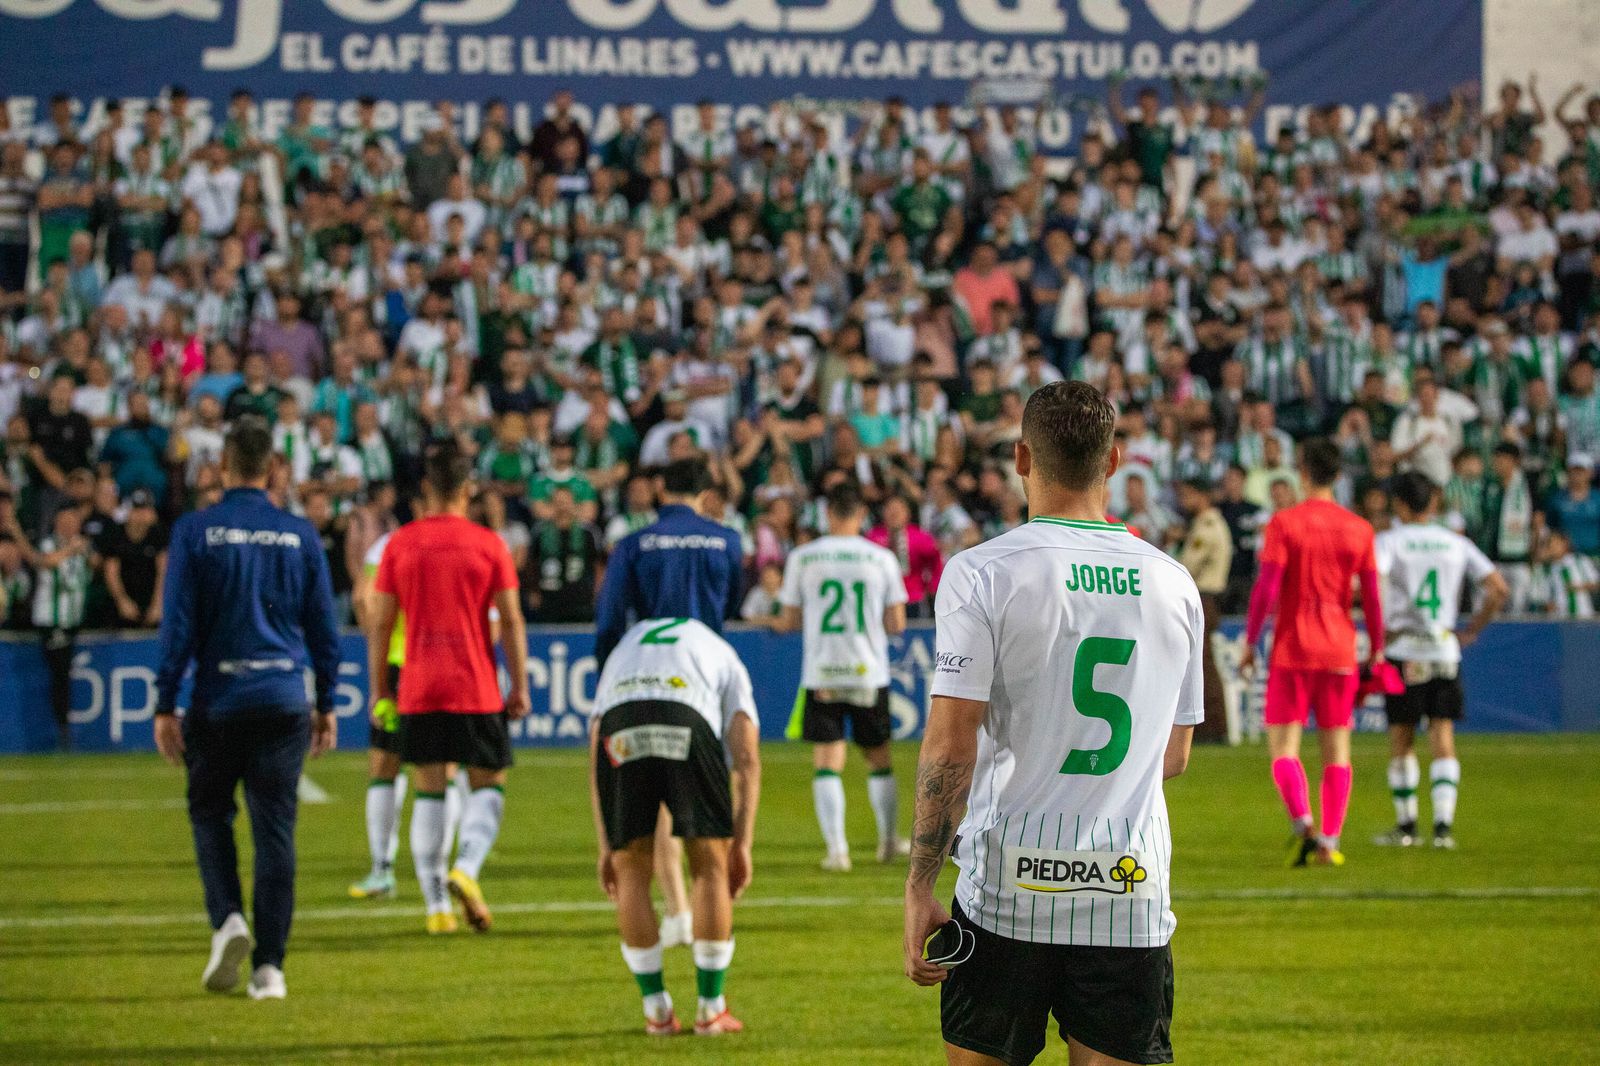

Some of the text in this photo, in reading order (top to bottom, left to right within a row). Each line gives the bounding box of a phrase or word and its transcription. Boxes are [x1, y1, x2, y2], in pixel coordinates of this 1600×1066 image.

[279, 32, 335, 72] EL
[341, 25, 450, 74] CAFÉ
[457, 34, 515, 75] DE
[521, 37, 699, 77] LINARES
[819, 578, 866, 634] 21
[1065, 563, 1142, 596] JORGE
[1415, 567, 1441, 620] 4
[1058, 636, 1137, 776] 5
